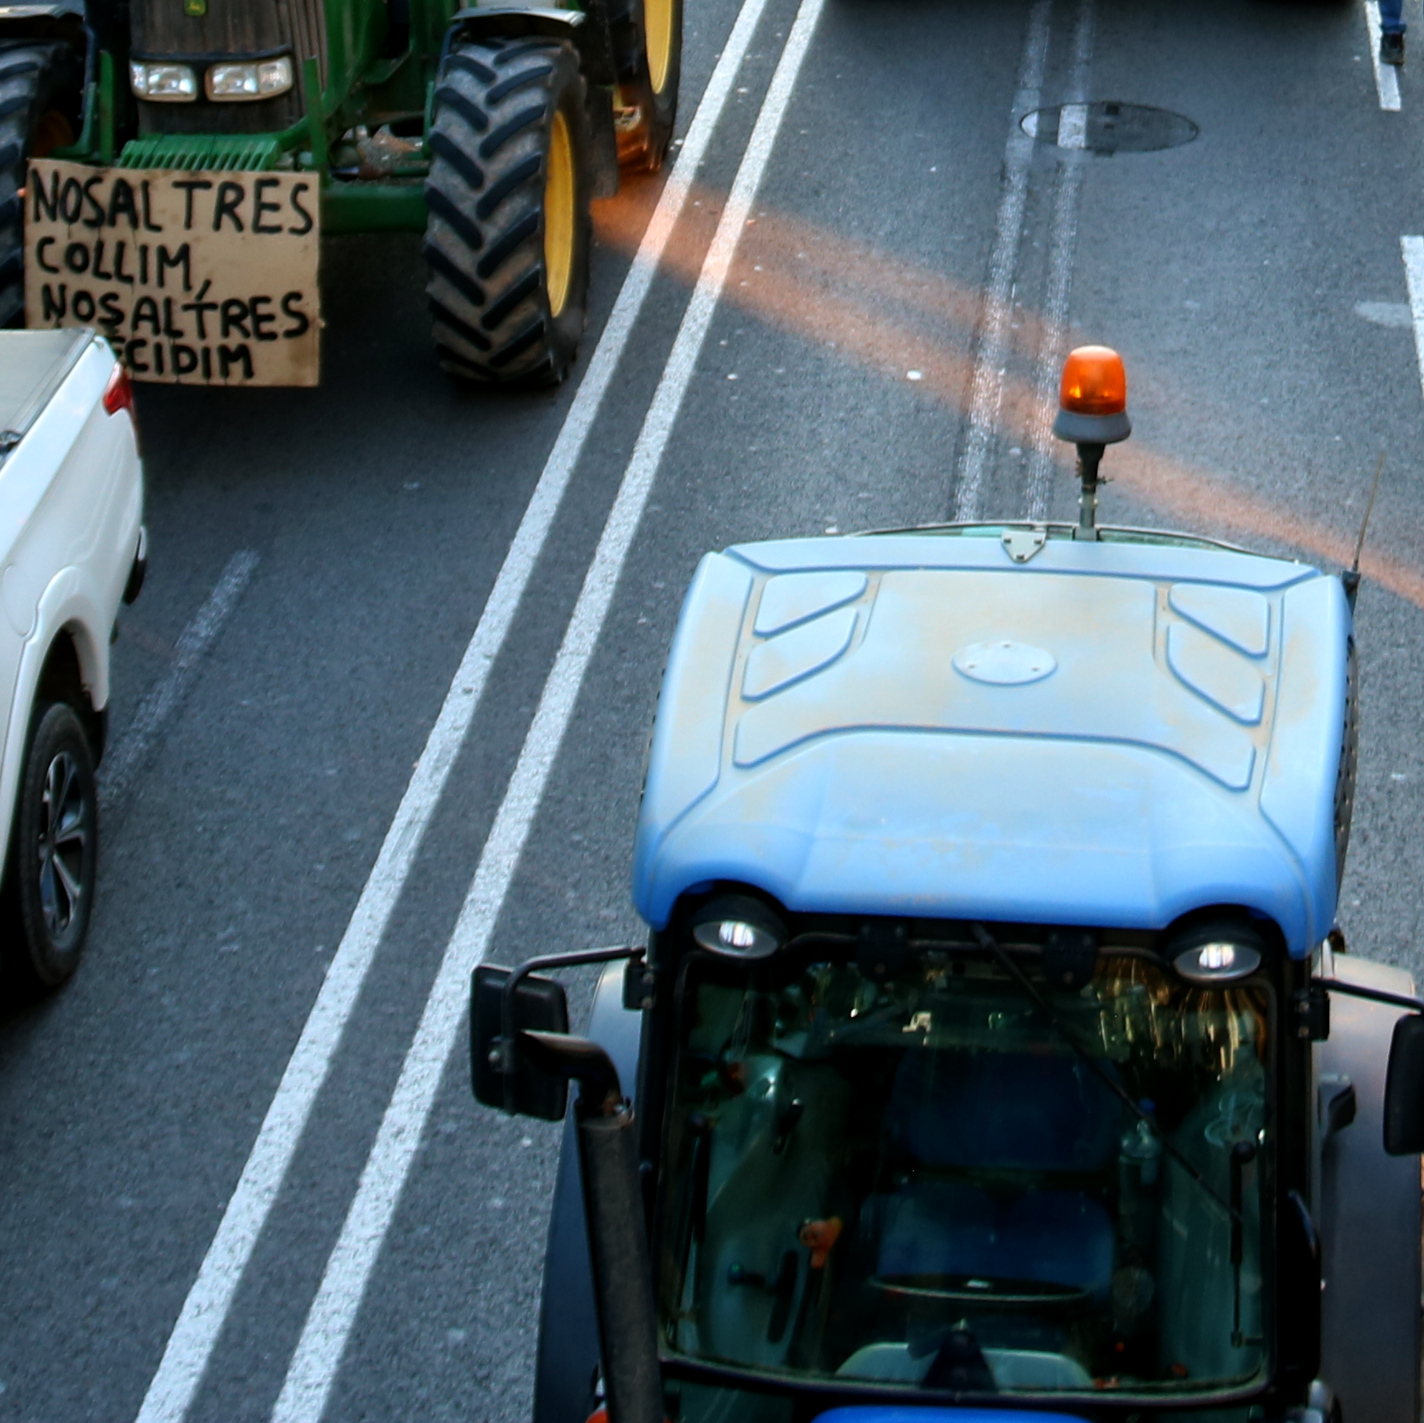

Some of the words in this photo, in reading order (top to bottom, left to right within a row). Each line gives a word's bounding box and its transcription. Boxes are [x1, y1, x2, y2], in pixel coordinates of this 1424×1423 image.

[31, 168, 314, 235] NOSALTRES
[41, 283, 310, 342] NOSALTRES
[106, 336, 255, 380] CIDIM
